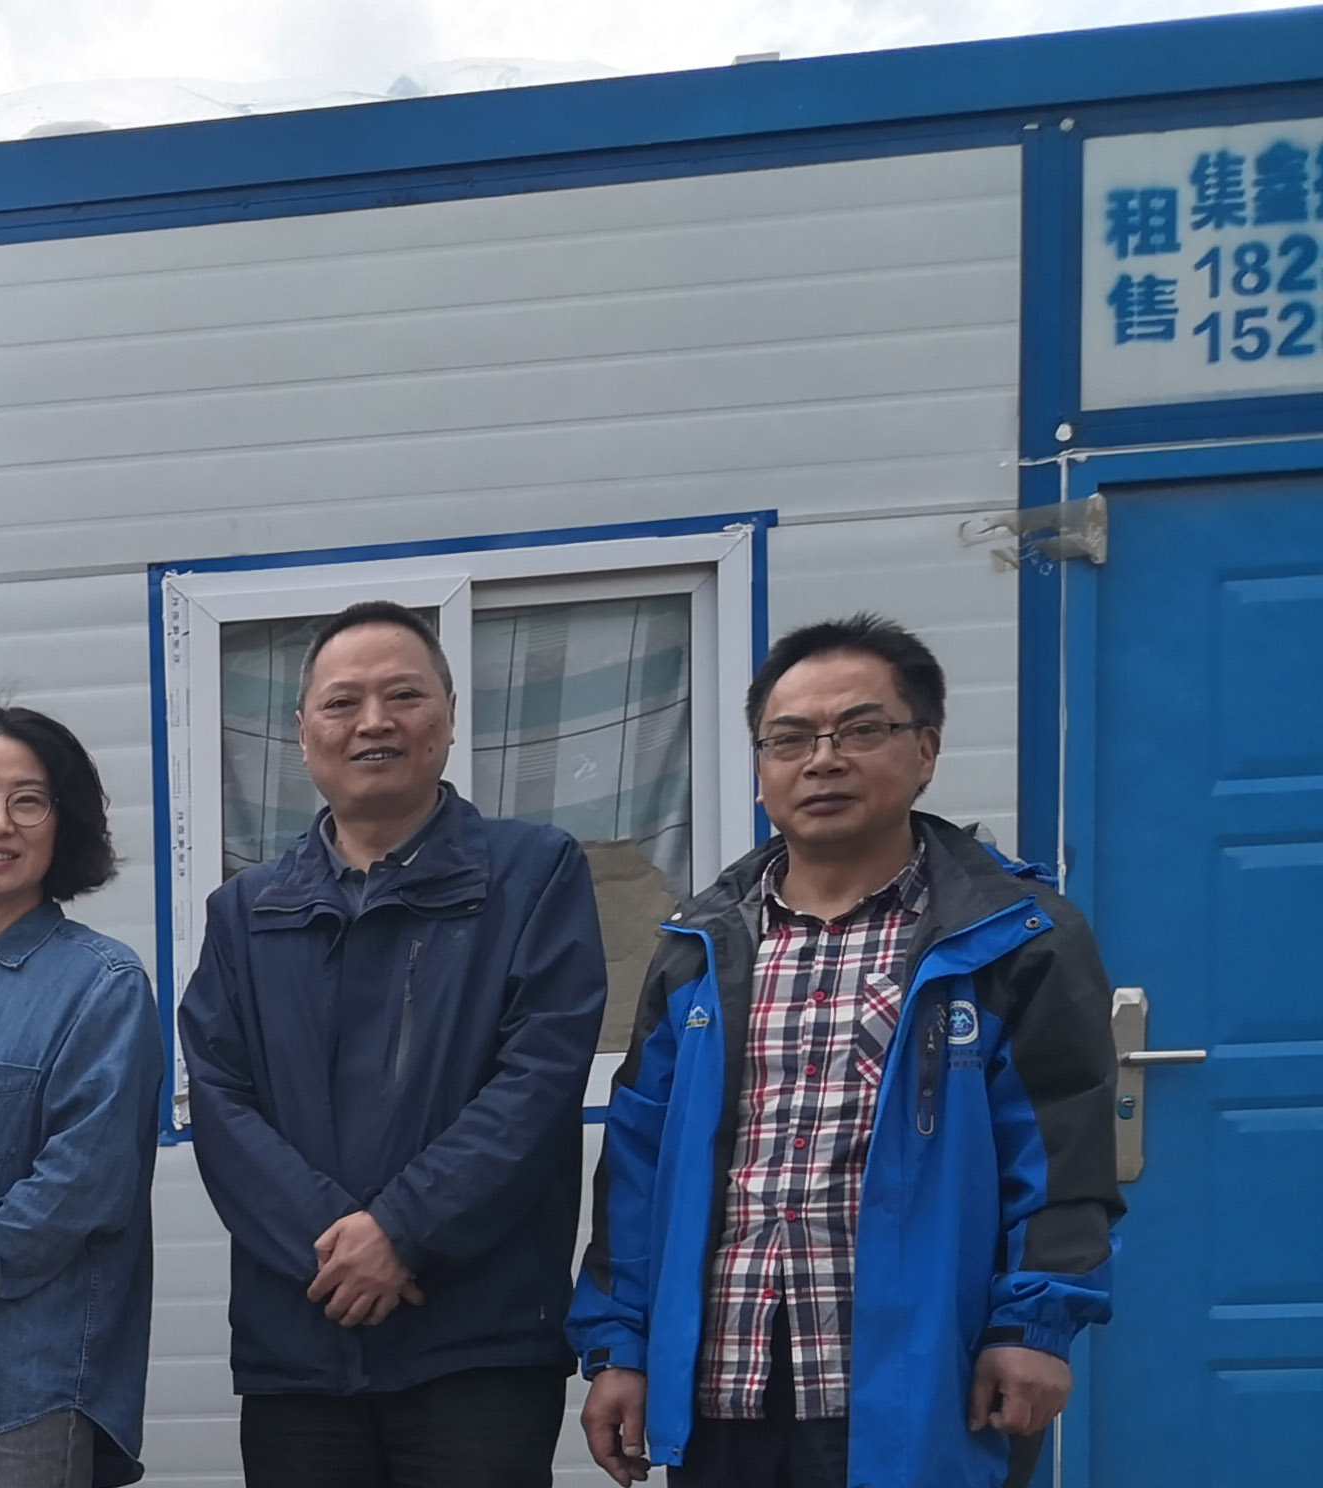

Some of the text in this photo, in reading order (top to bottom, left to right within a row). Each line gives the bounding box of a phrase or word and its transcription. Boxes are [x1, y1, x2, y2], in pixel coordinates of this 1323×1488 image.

[1189, 140, 1323, 232] 集鑫
[1193, 233, 1323, 299] 182
[1192, 301, 1323, 364] 152
